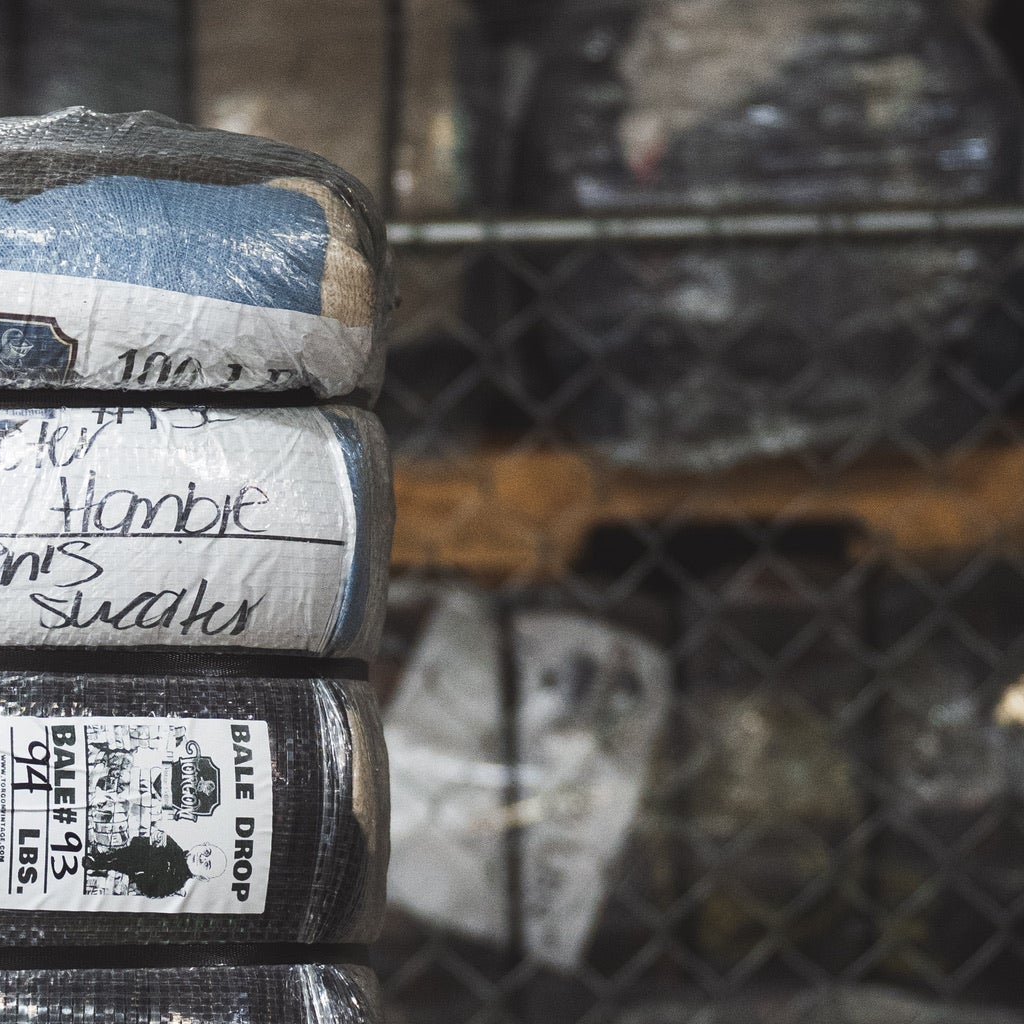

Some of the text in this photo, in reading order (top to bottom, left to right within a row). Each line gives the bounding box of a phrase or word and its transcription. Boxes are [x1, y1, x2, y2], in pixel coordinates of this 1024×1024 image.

[11, 740, 53, 894] 94 LBS.
[50, 724, 82, 880] BALE# 93
[230, 724, 255, 902] BALE DROP
